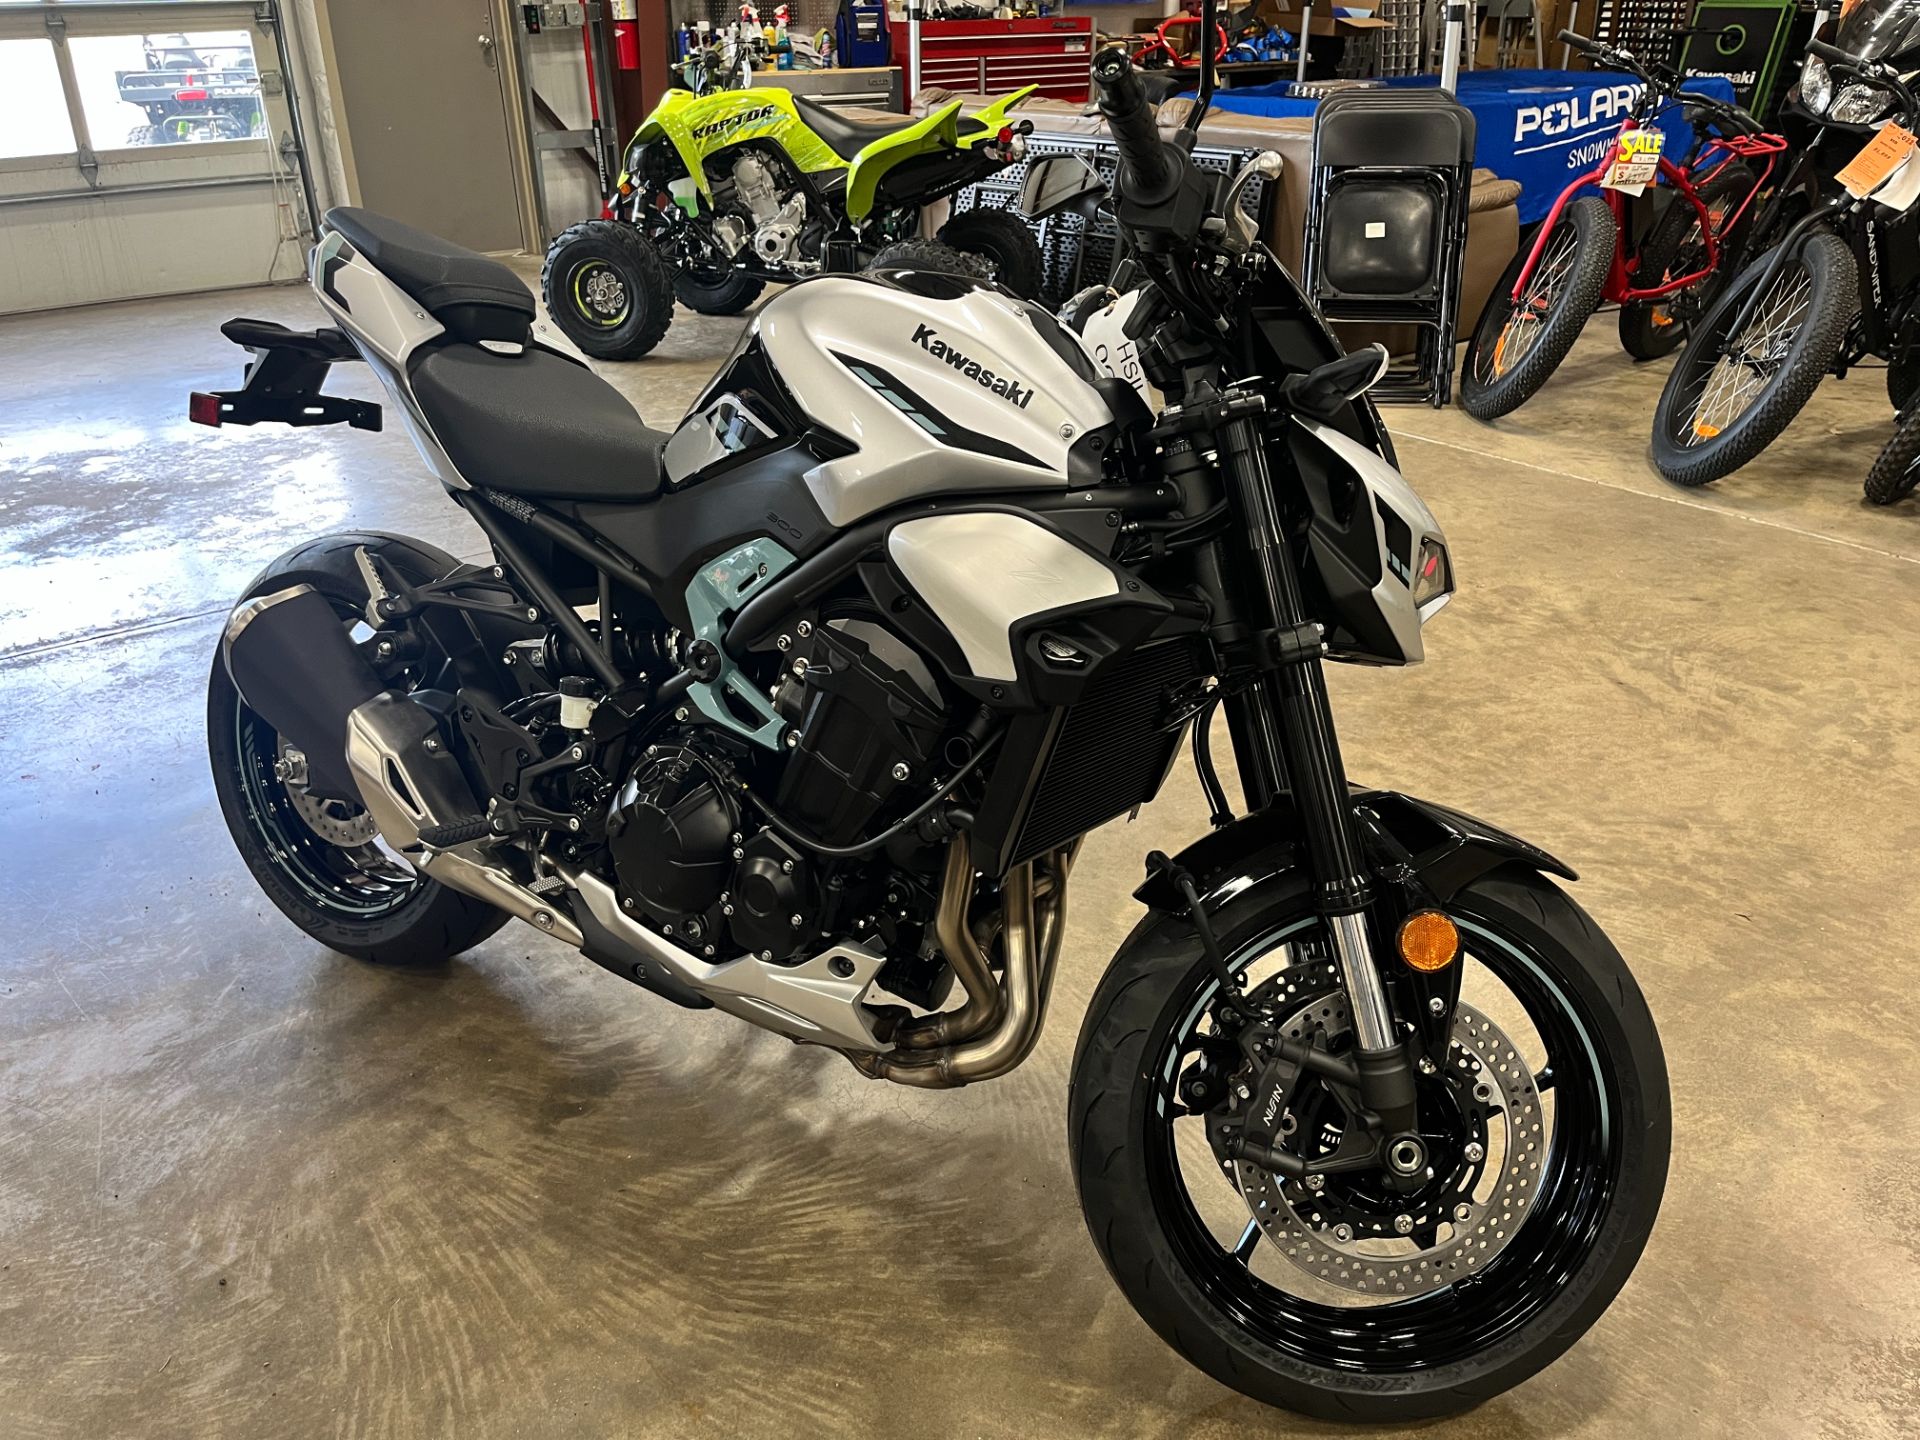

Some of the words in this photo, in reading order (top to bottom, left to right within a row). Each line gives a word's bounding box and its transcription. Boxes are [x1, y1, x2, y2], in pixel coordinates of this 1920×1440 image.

[692, 104, 776, 140] RAPTOR
[1618, 130, 1664, 162] SALE
[911, 322, 1034, 410] Kawasaki
